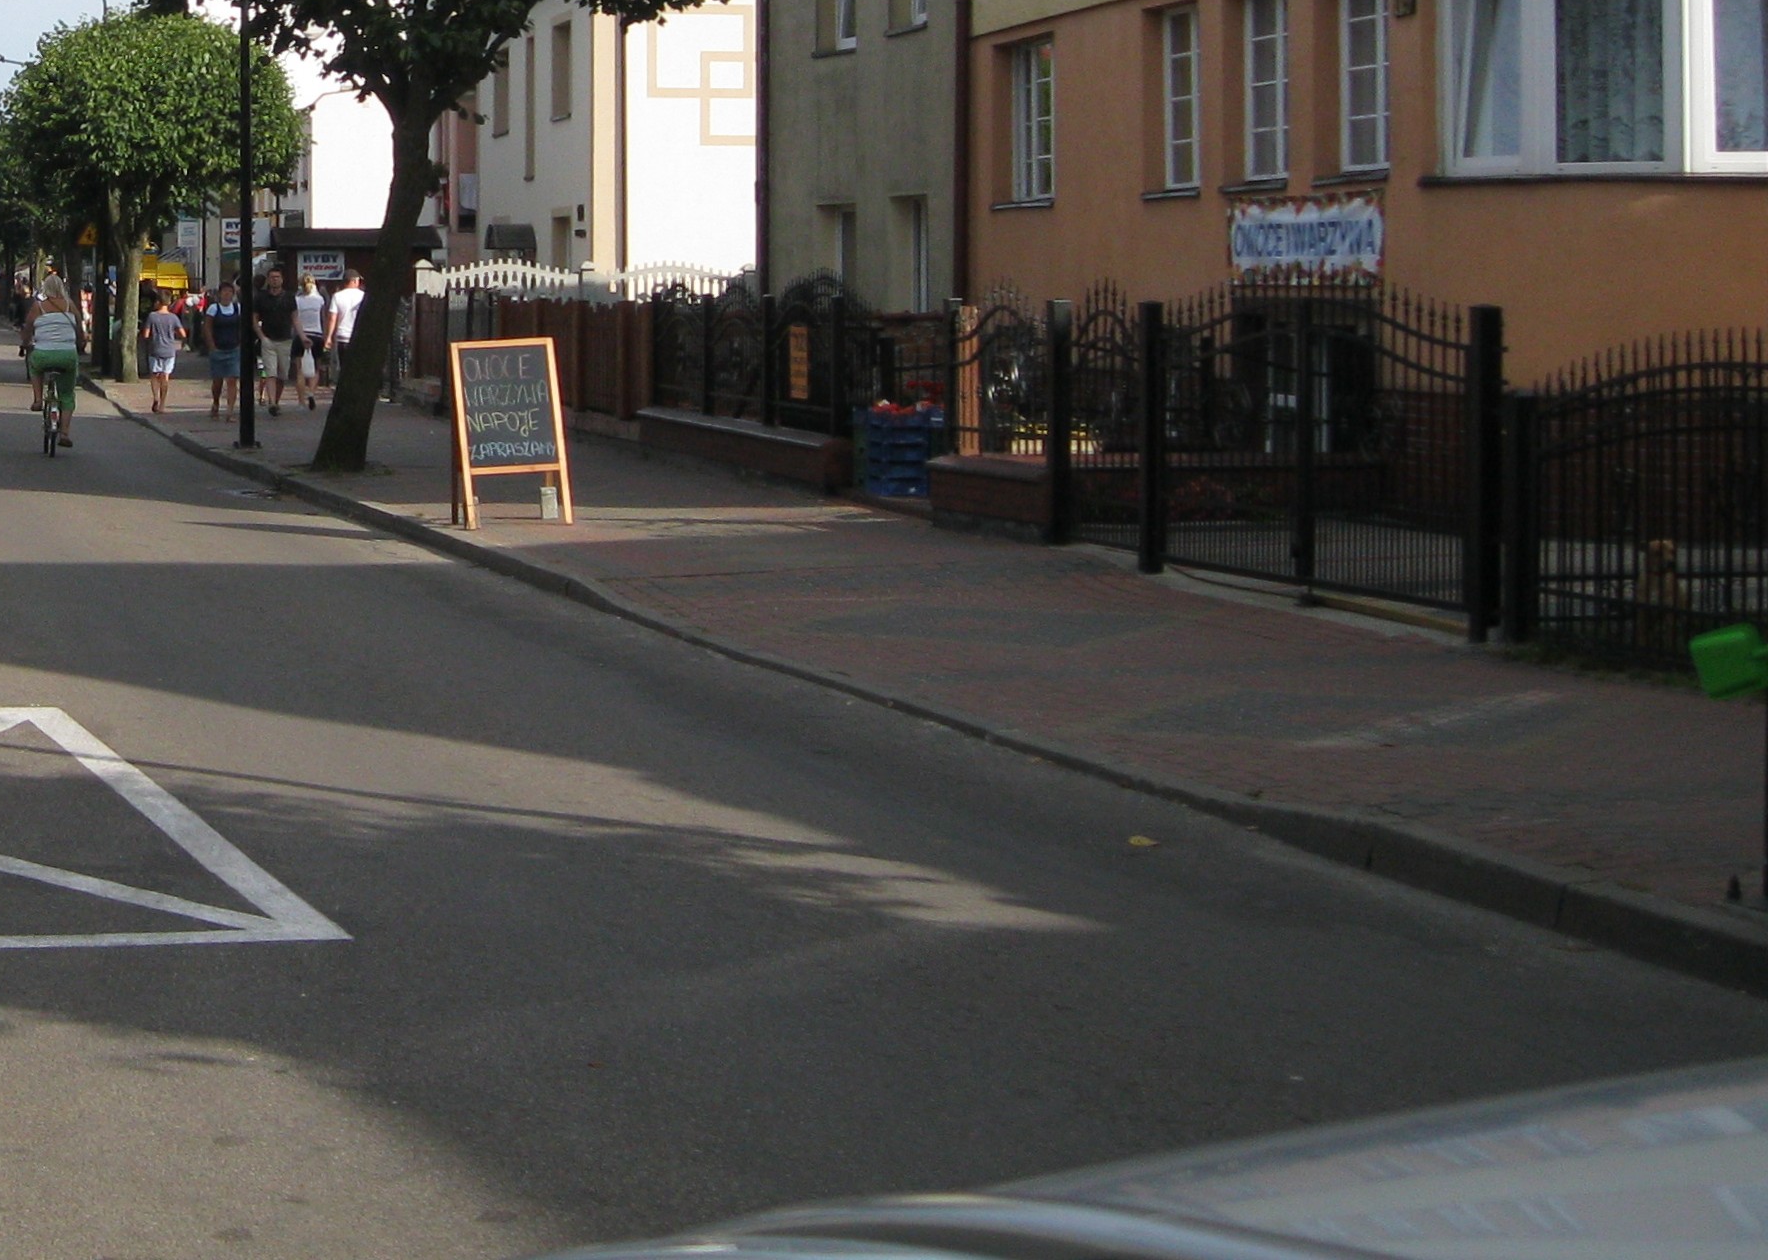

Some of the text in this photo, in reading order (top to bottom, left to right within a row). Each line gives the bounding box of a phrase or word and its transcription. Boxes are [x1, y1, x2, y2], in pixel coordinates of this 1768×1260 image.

[1234, 222, 1283, 258] OWOCE
[1291, 218, 1377, 256] WARZYWA
[302, 254, 339, 264] RYBY
[462, 352, 532, 382] OWOCE
[463, 380, 550, 408] WARZYWA
[466, 407, 540, 437] NAPOJE
[468, 440, 557, 461] ZAPRASZAMY
